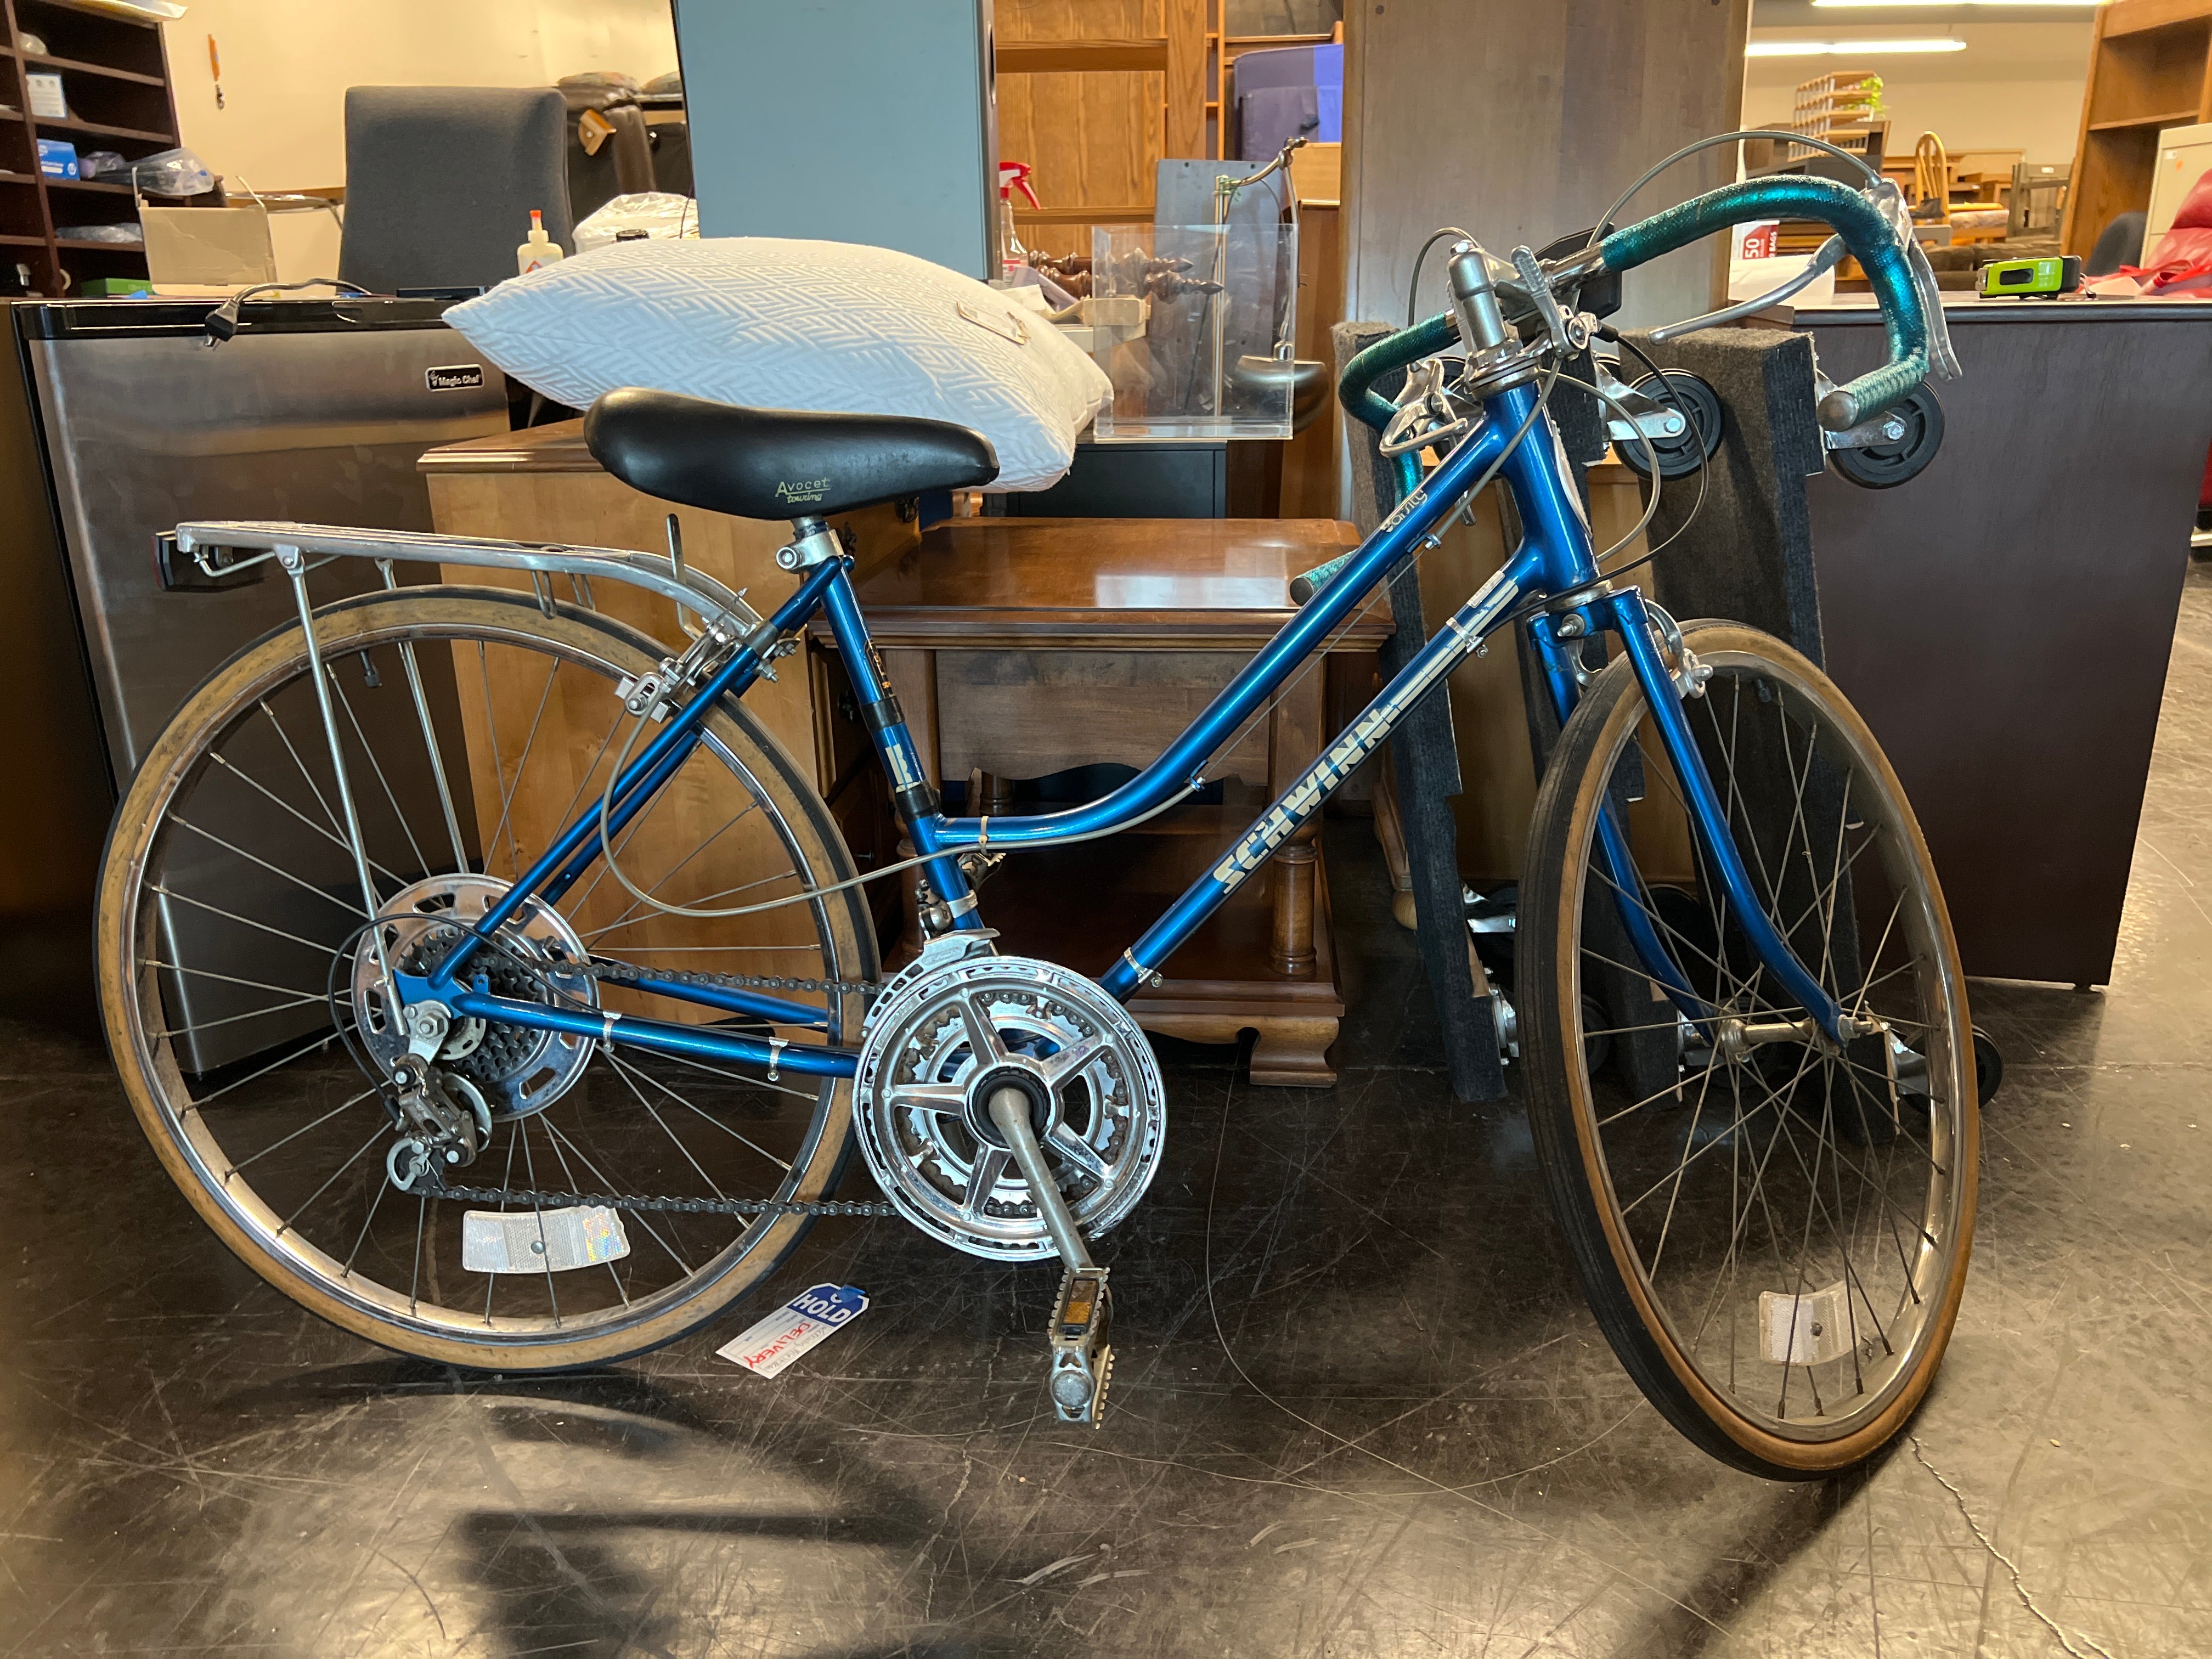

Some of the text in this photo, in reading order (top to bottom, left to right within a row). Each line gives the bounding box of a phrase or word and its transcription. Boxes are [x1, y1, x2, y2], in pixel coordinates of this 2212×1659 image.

[1745, 238, 1760, 258] 50
[1769, 232, 1777, 252] BAGS
[439, 375, 479, 386] Magic Chef
[775, 477, 831, 497] Avocet
[787, 492, 823, 503] touring
[1212, 708, 1391, 895] SCHWINN
[793, 1294, 851, 1323] HOLD
[743, 1322, 811, 1369] DELIVERY
